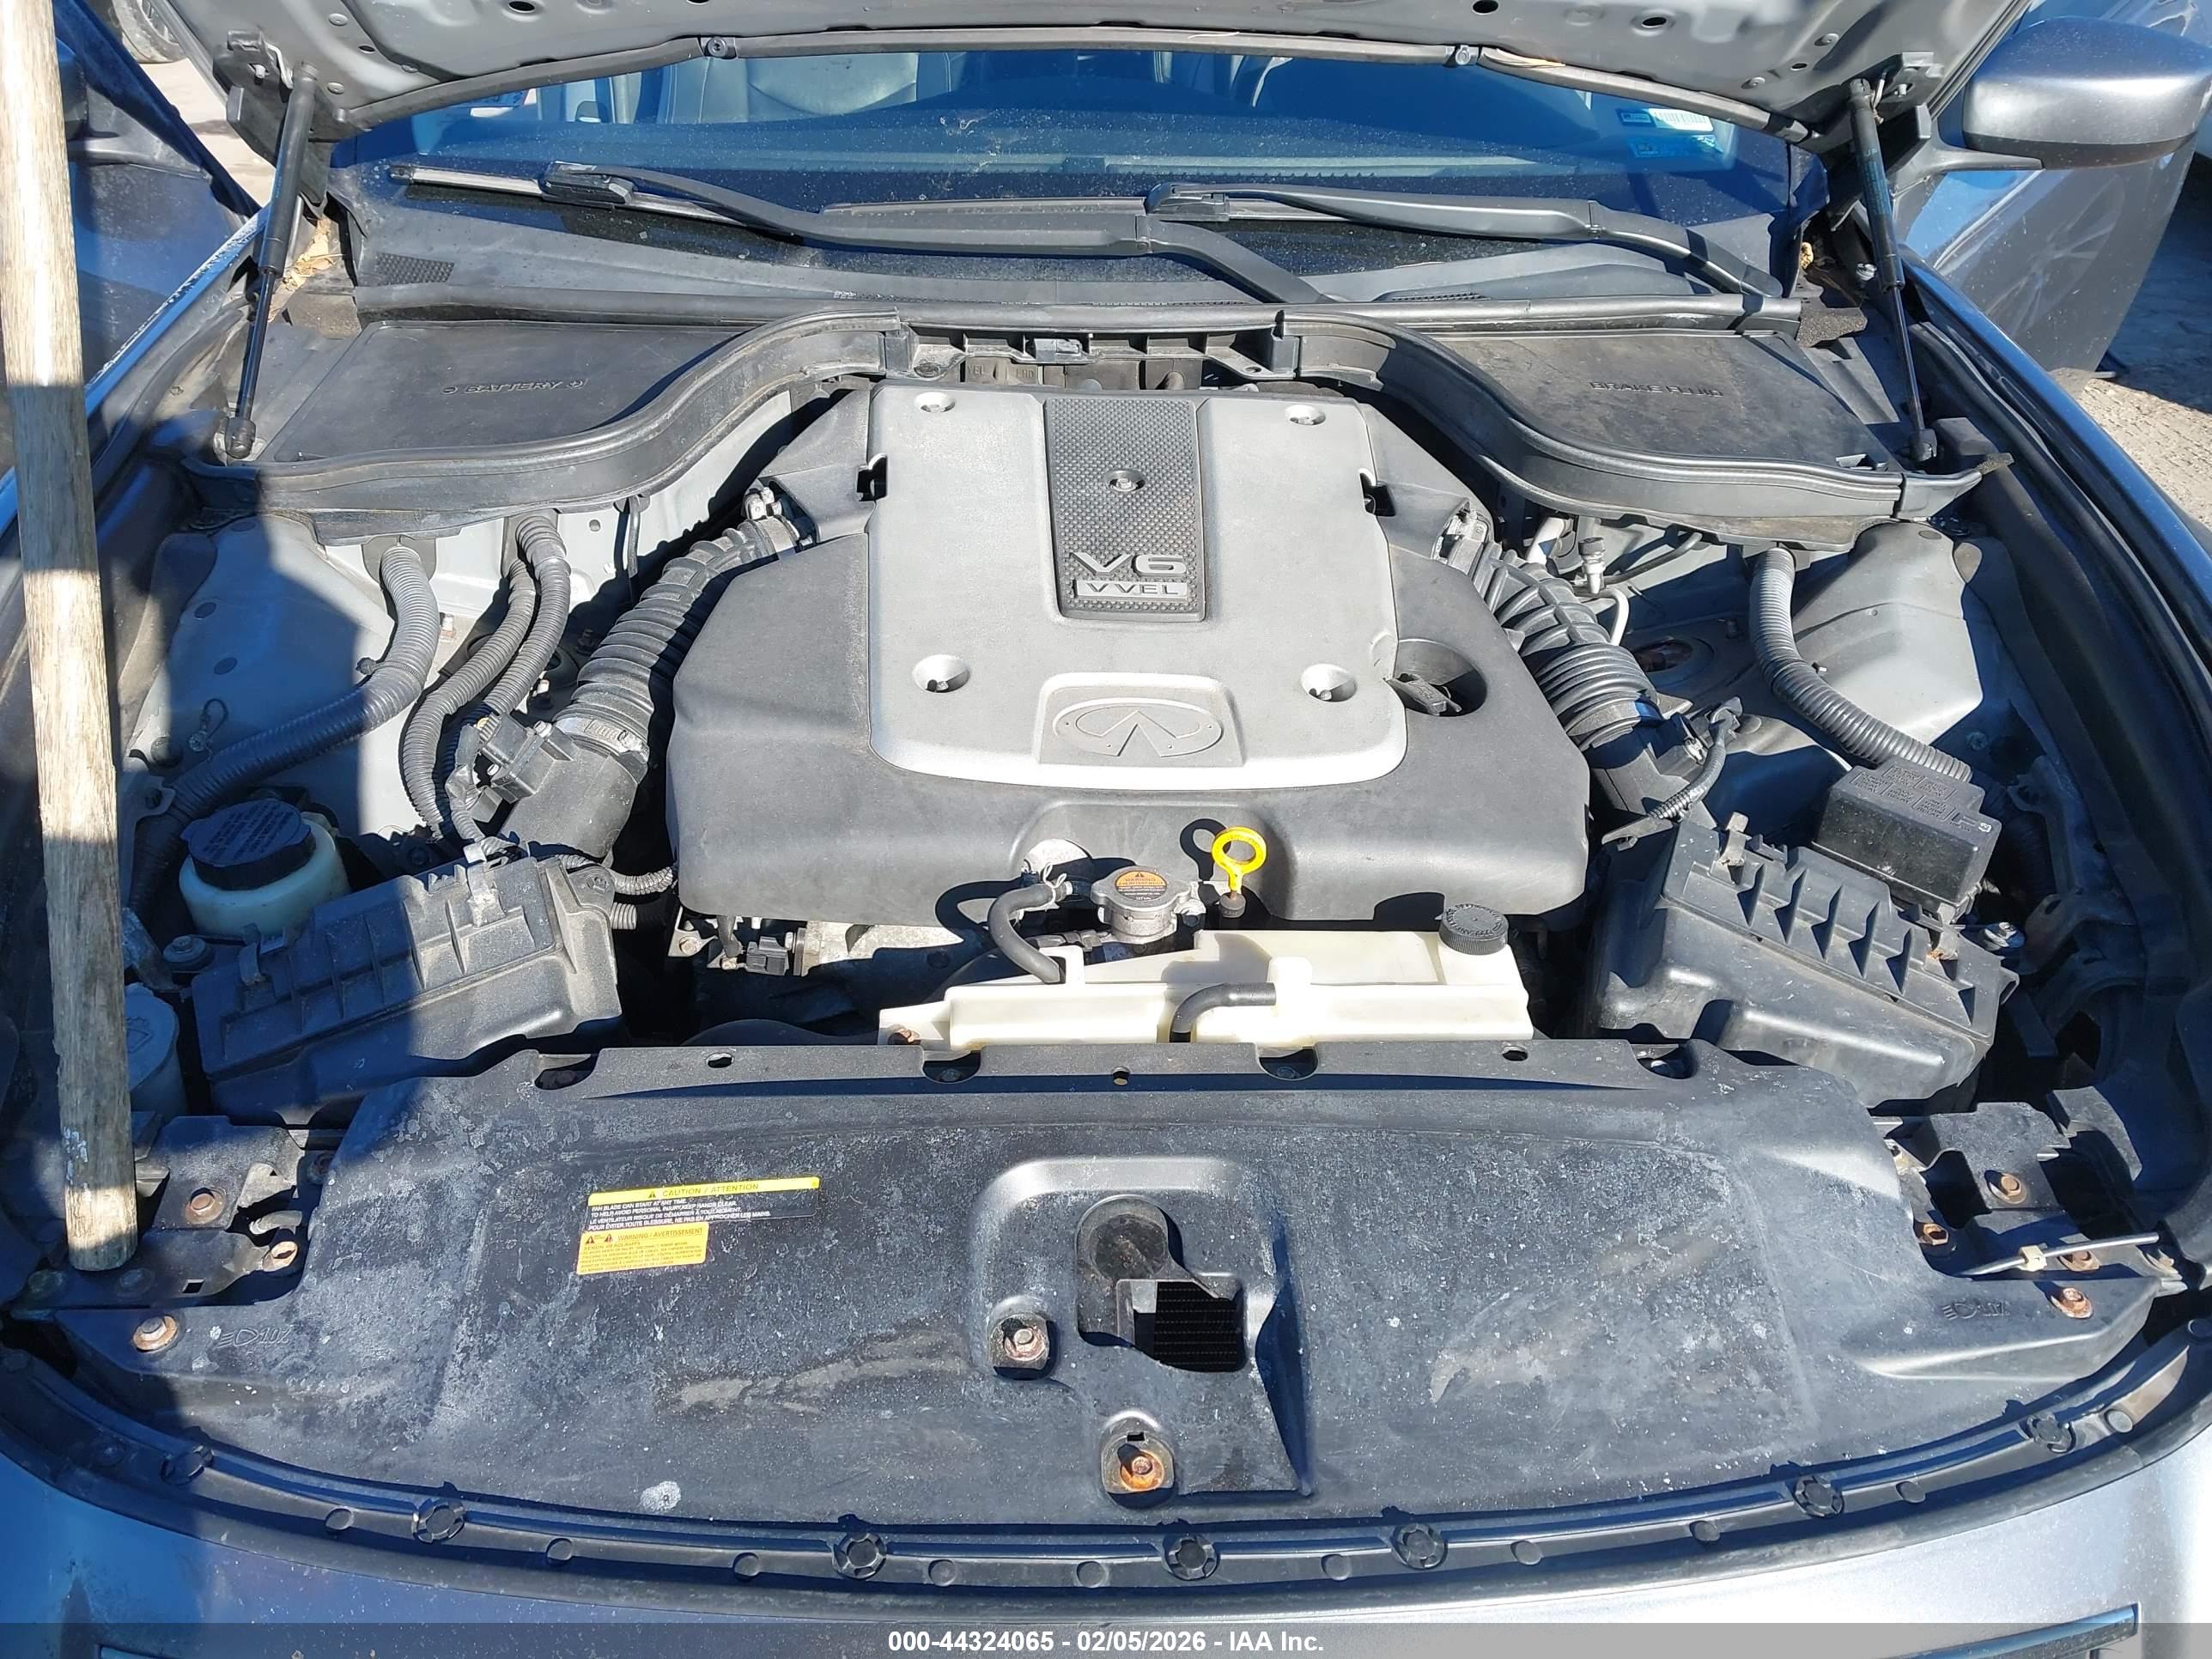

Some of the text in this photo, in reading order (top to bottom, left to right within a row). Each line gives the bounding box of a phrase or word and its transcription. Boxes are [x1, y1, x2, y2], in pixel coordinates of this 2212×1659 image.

[465, 380, 563, 394] BATTERY
[1589, 381, 1724, 398] BRAKE FLUID
[1069, 551, 1188, 576] V6
[1085, 582, 1178, 595] VVEL
[662, 1187, 701, 1197] CAUTION
[711, 1183, 759, 1194] ATTENTION
[598, 1216, 633, 1224] VENTILATEUR
[617, 1233, 648, 1242] WARNING
[654, 1228, 702, 1237] AVERTISSEMENT
